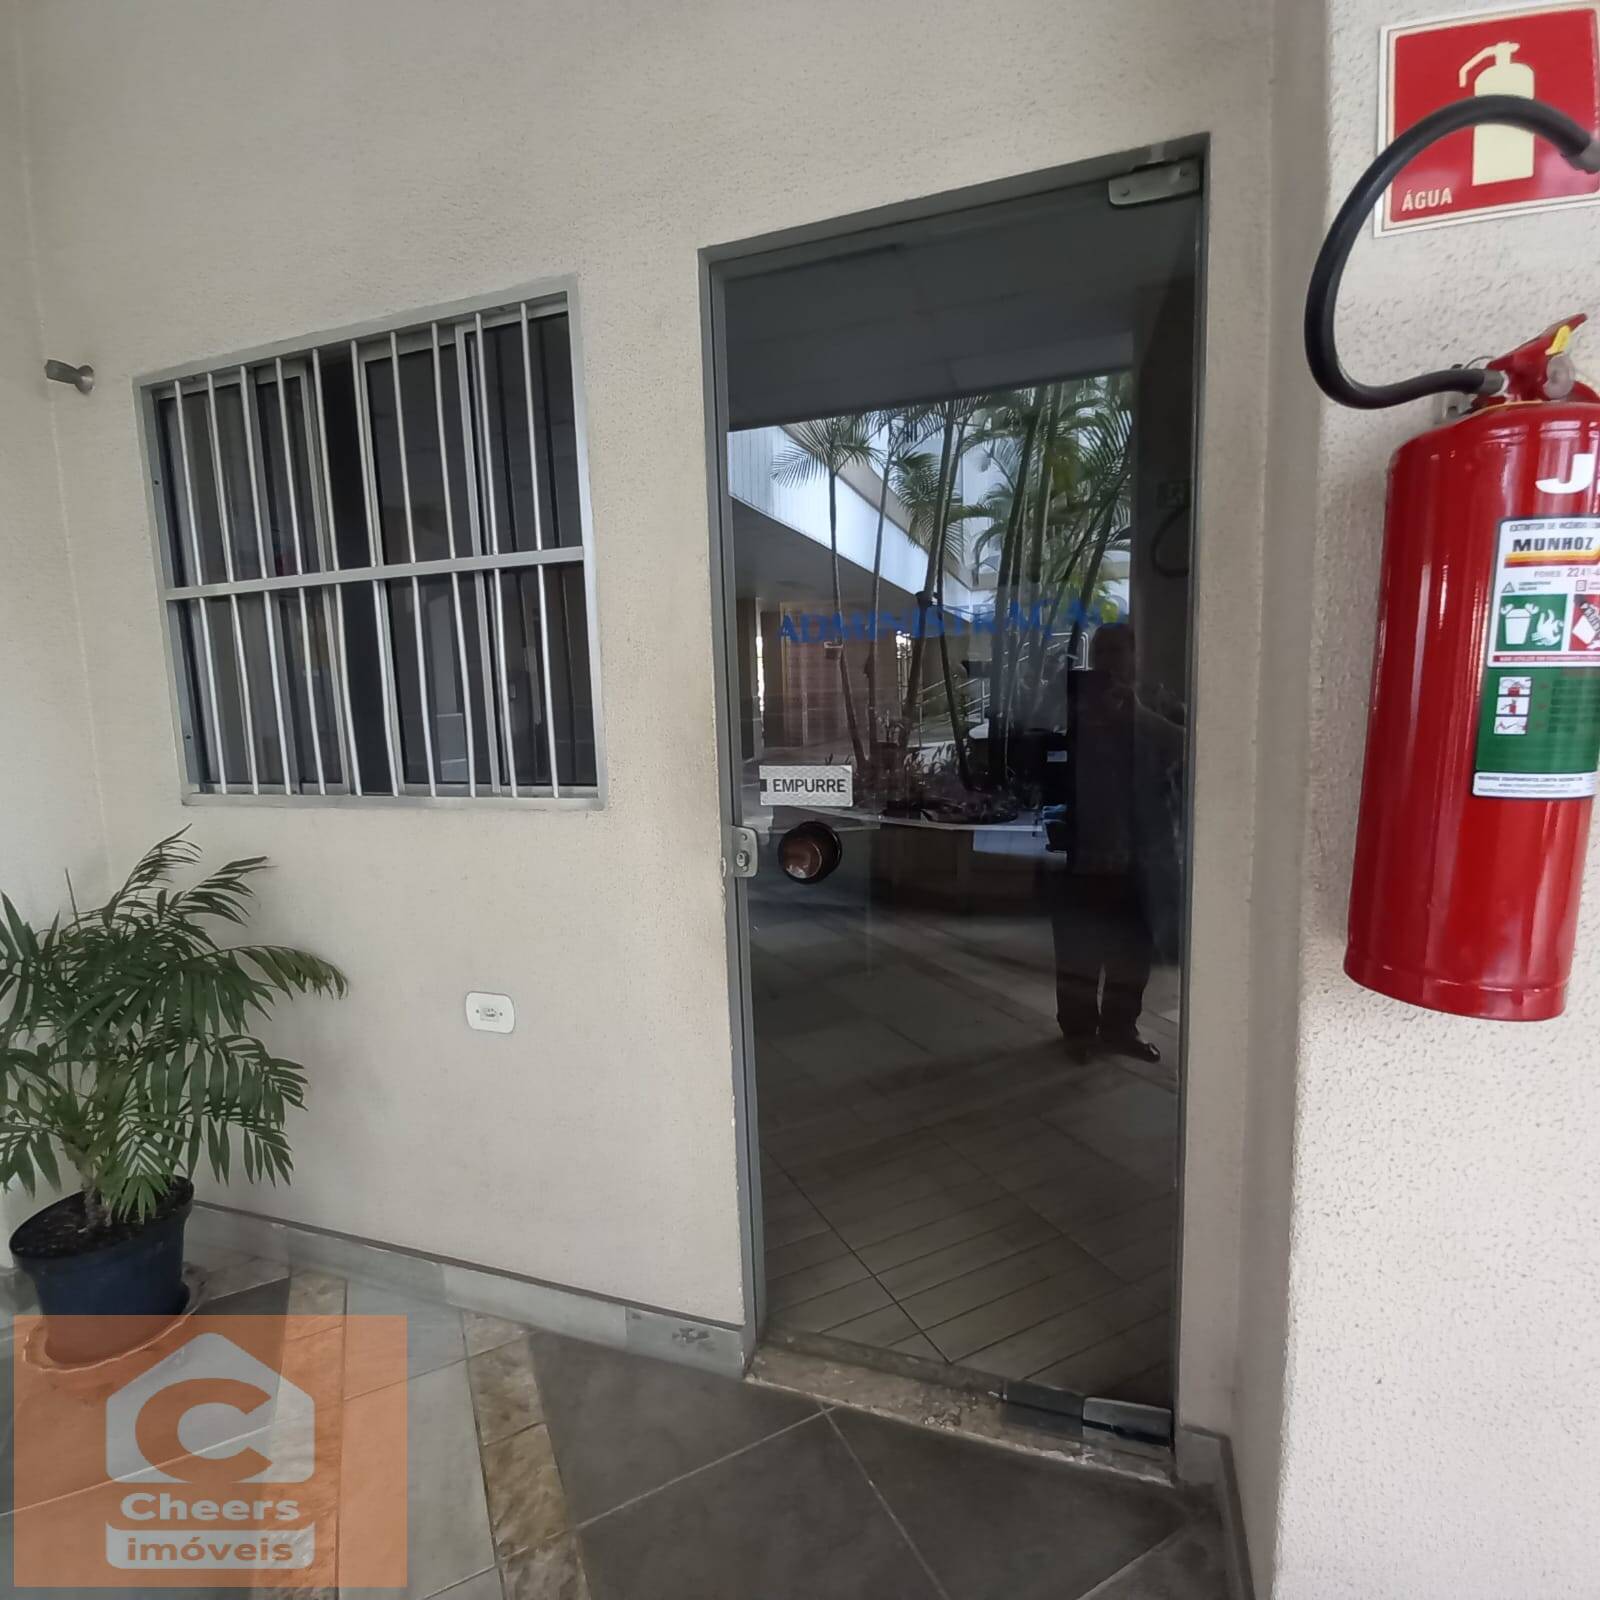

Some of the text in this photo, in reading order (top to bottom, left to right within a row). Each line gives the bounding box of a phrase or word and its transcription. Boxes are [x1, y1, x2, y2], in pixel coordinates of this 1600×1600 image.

[1401, 187, 1453, 212] ÁGUA
[1512, 536, 1594, 553] MUNHOZ
[772, 778, 847, 793] EMPURRE
